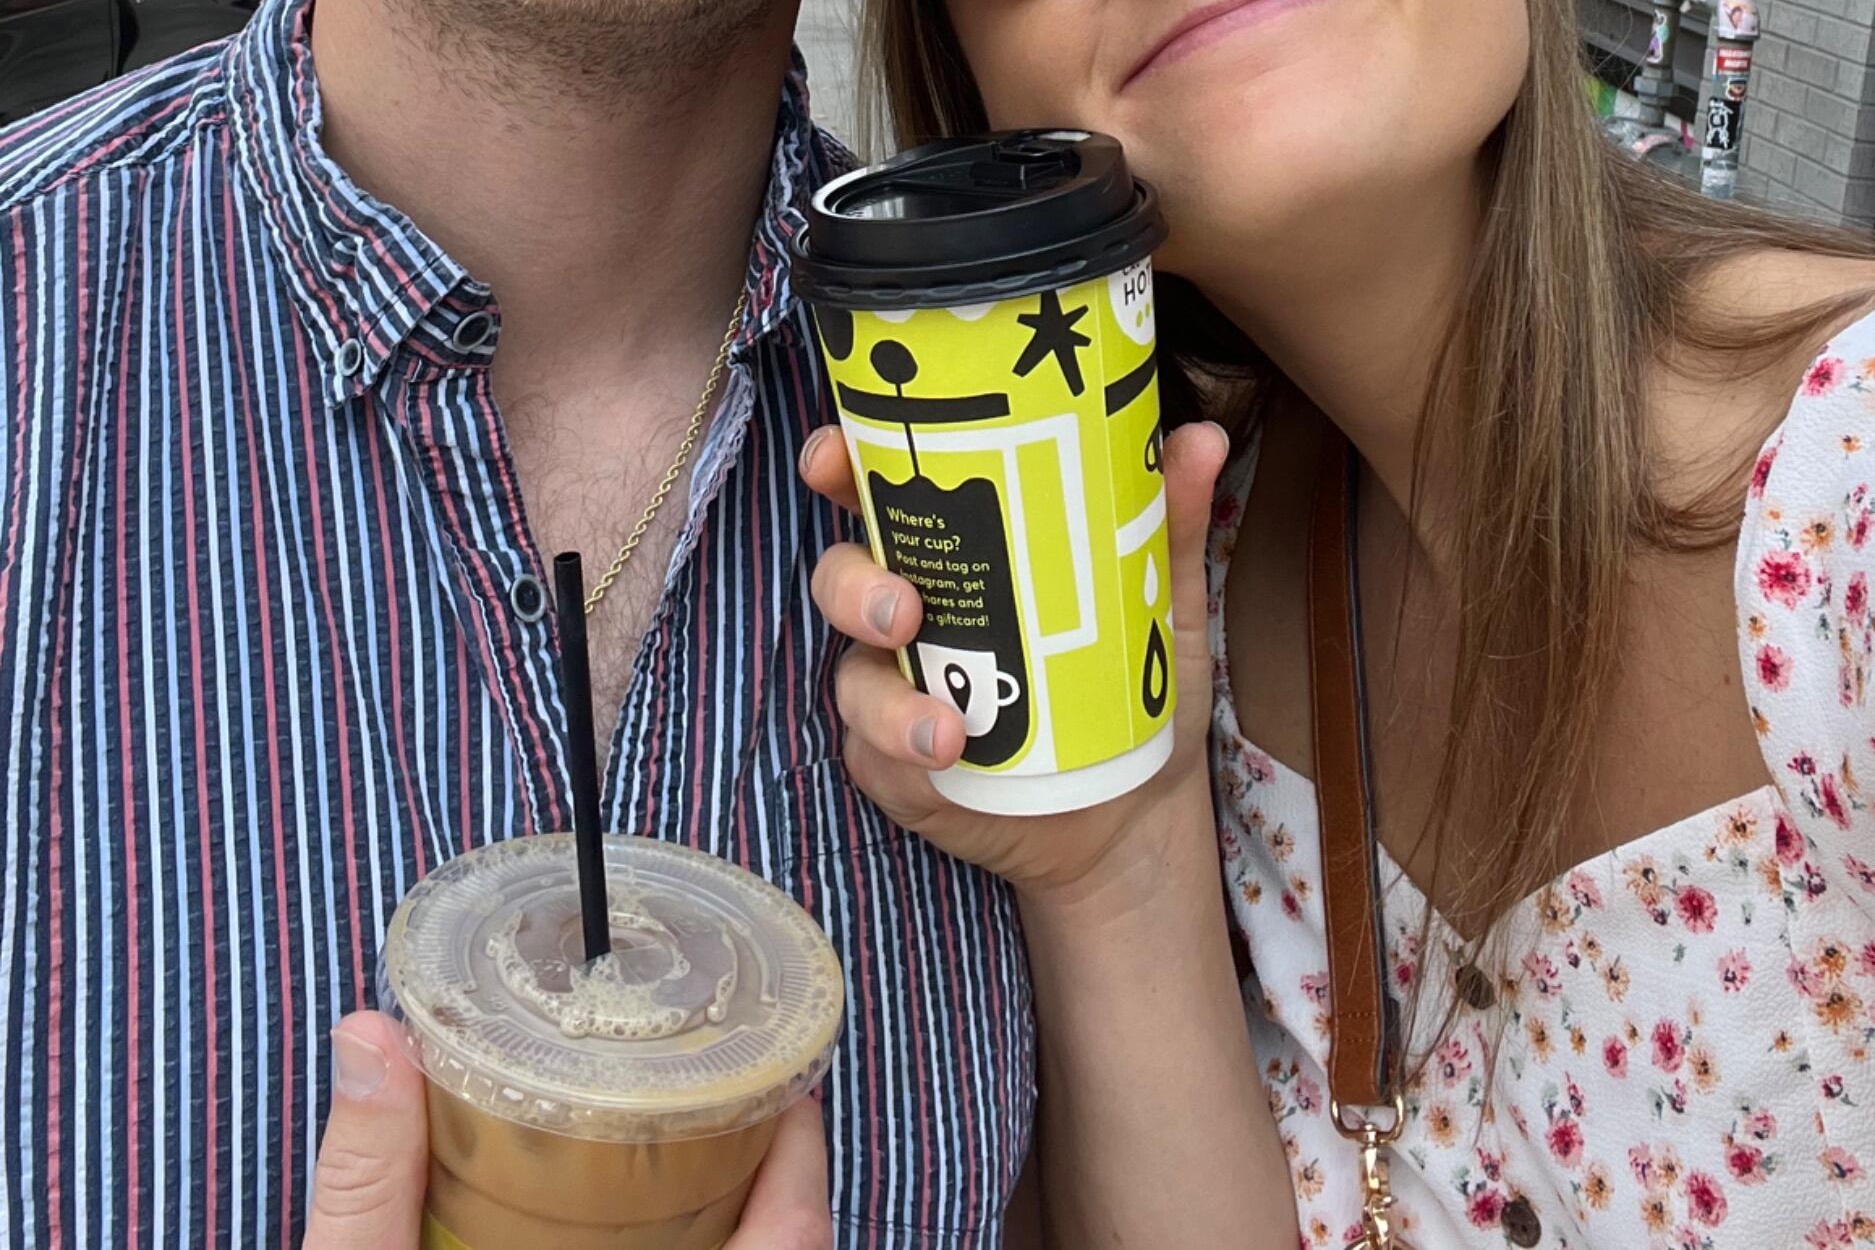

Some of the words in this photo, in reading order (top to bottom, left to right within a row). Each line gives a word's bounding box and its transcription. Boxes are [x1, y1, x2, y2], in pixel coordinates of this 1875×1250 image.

[886, 506, 945, 529] Where's
[892, 531, 920, 546] your
[924, 535, 961, 554] cup?
[896, 550, 919, 567] Post
[920, 558, 944, 570] and
[946, 560, 969, 575] tag
[972, 562, 990, 572] on
[963, 579, 987, 593] get
[922, 591, 955, 608] hares
[958, 596, 984, 609] and
[926, 612, 935, 622] a
[936, 613, 990, 627] giftcard!
